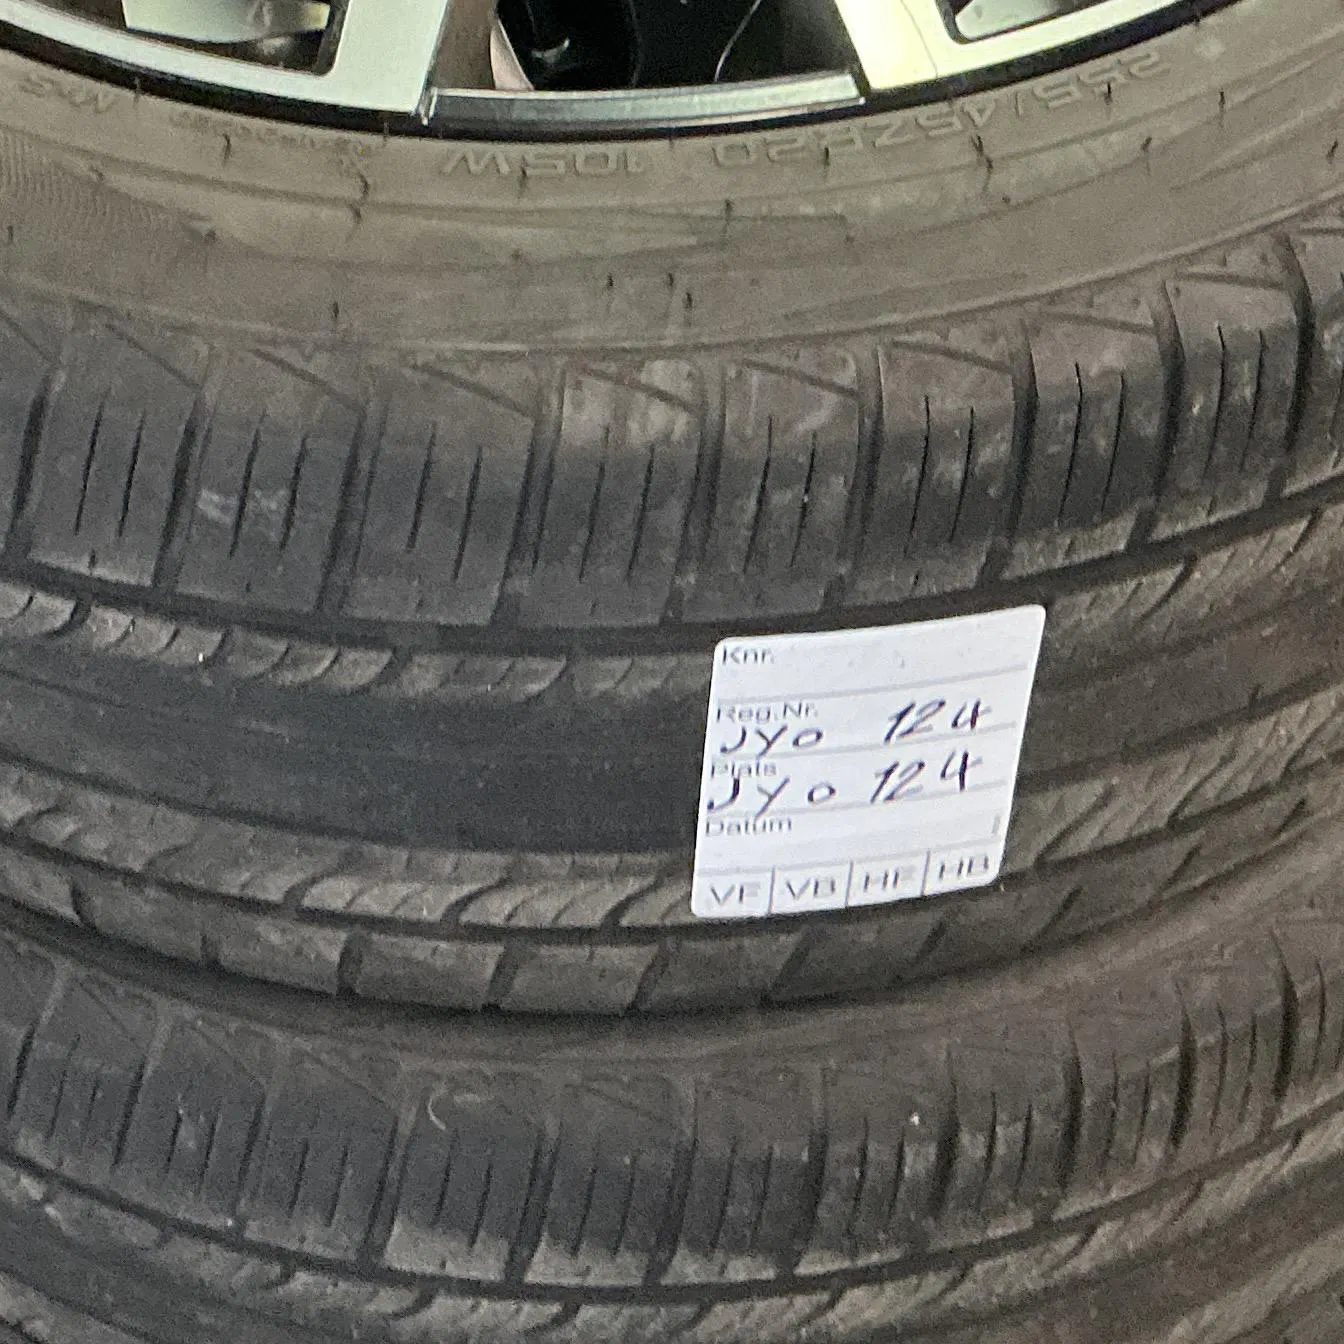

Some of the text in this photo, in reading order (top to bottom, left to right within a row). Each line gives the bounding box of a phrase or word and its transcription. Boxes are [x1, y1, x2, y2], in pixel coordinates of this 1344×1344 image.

[440, 147, 646, 179] 105W
[884, 698, 993, 745] 124
[710, 760, 778, 779] Plats
[870, 750, 984, 804] 124
[704, 816, 793, 838] Datum
[785, 876, 837, 900] VB
[863, 867, 915, 892] HF
[709, 884, 761, 906] VF
